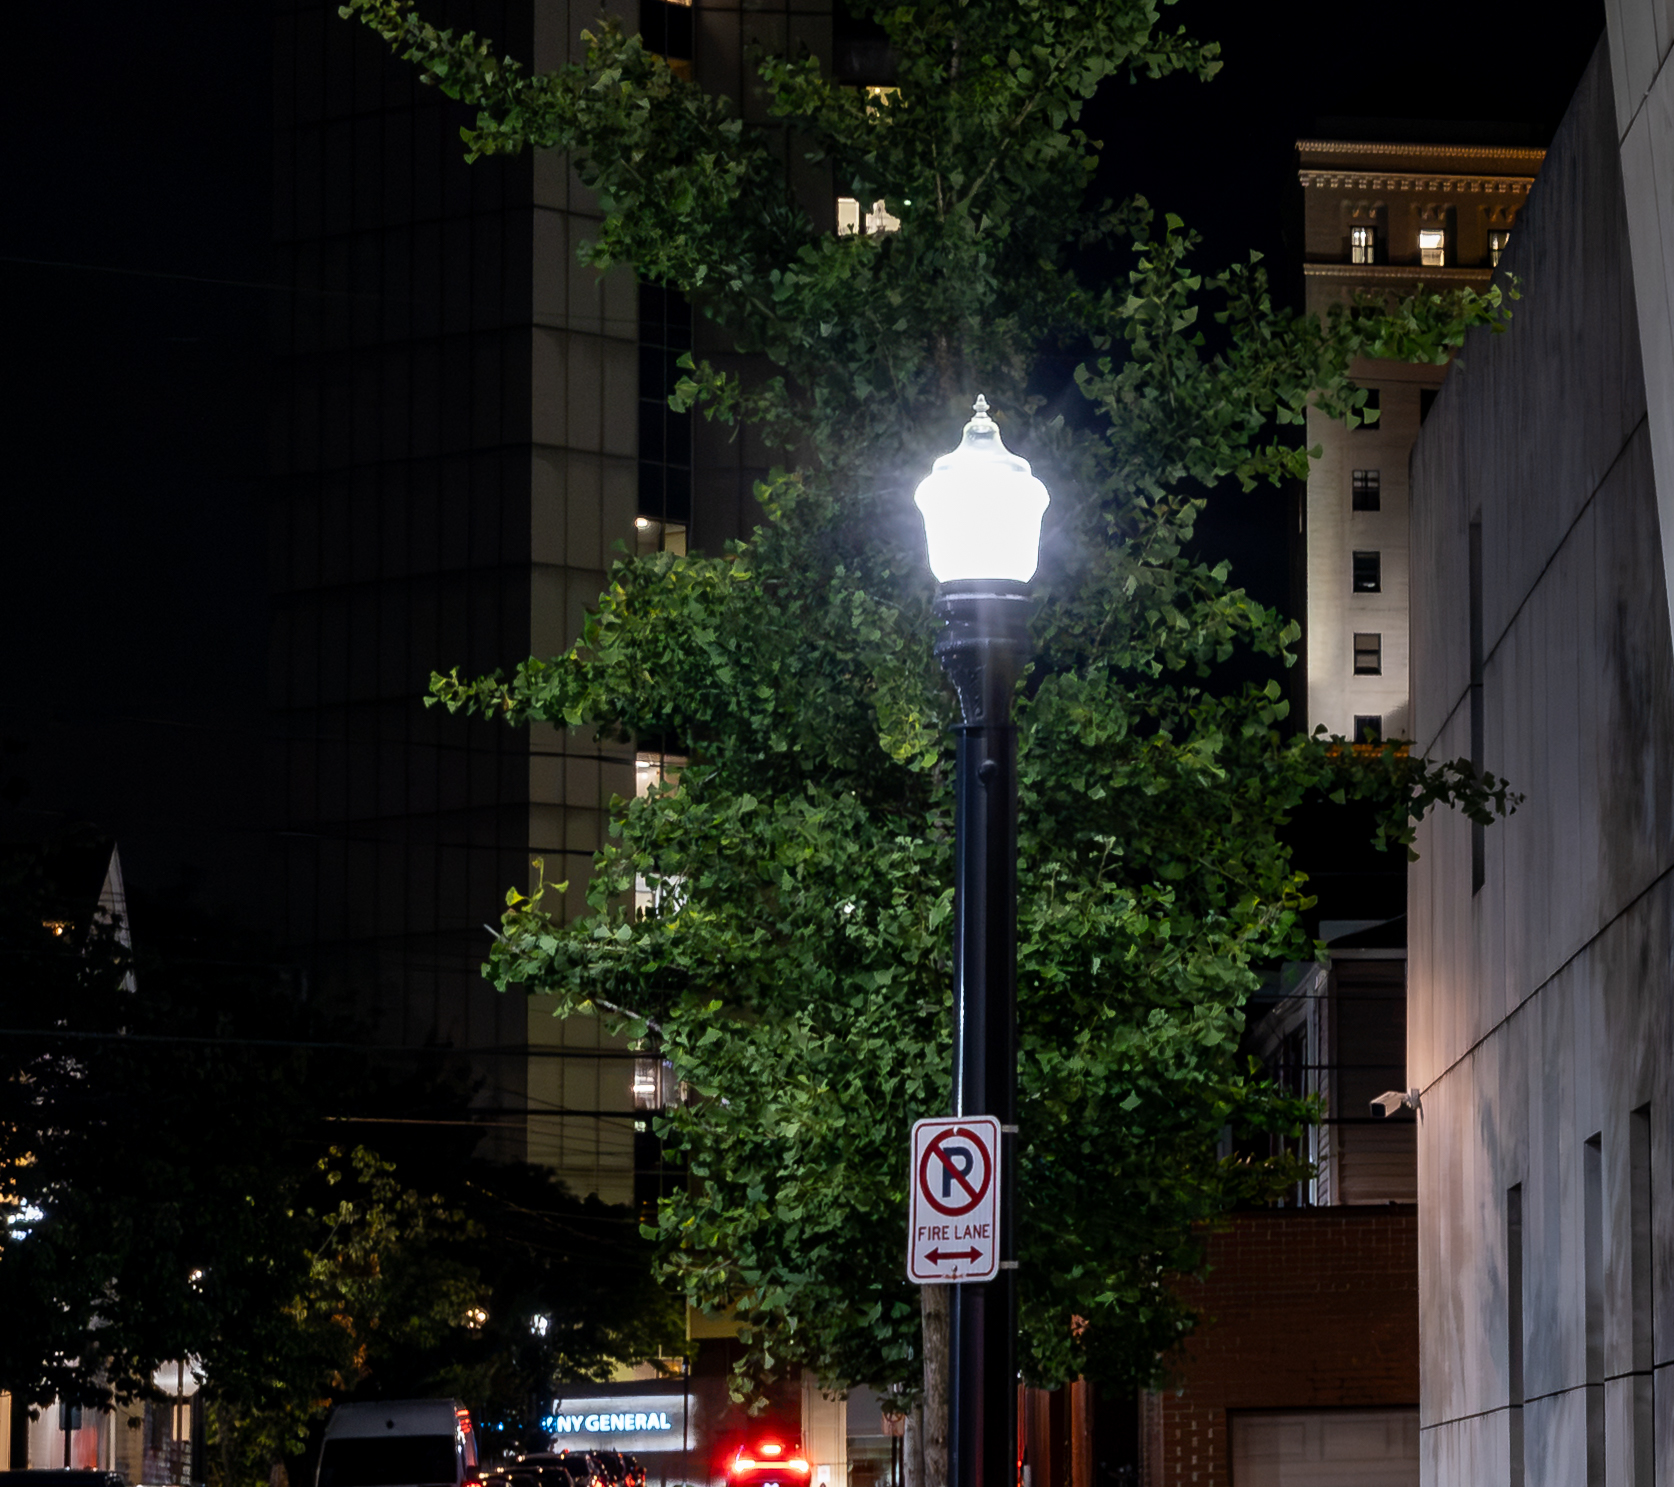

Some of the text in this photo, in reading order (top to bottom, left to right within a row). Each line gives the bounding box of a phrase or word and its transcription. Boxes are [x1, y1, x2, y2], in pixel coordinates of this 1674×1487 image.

[918, 1223, 990, 1242] FIRE LANE
[585, 1412, 671, 1432] GENERAL
